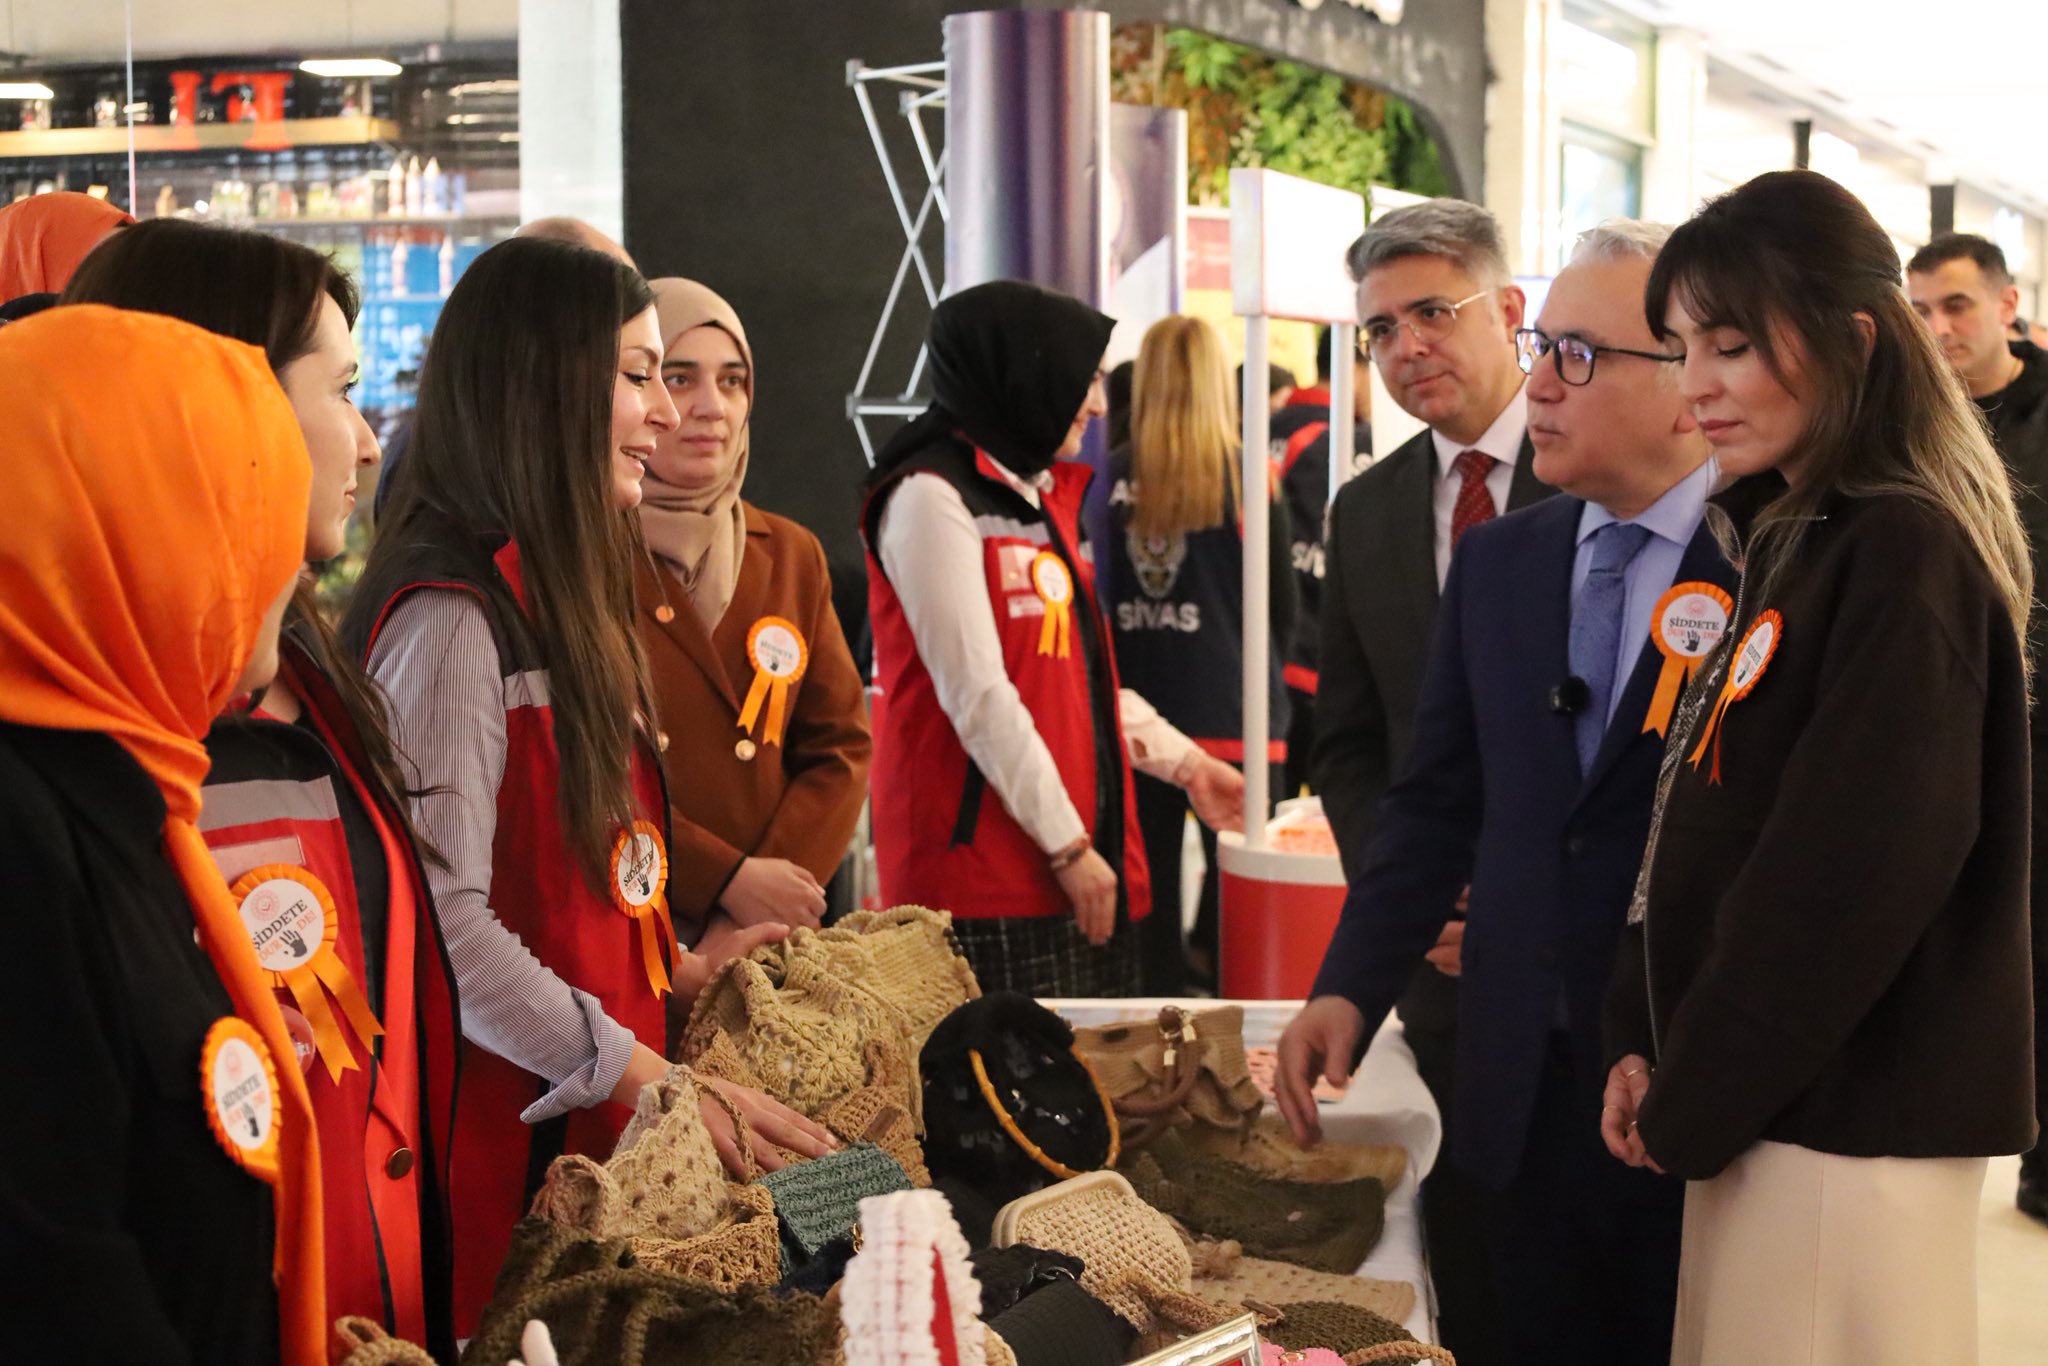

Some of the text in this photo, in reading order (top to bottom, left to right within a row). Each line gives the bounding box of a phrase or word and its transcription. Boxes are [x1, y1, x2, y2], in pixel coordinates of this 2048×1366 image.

[1117, 597, 1201, 633] SİVAS
[1669, 616, 1720, 631] ŞİDDETE
[252, 899, 308, 951] ŞİDDETE
[259, 939, 283, 961] DUR
